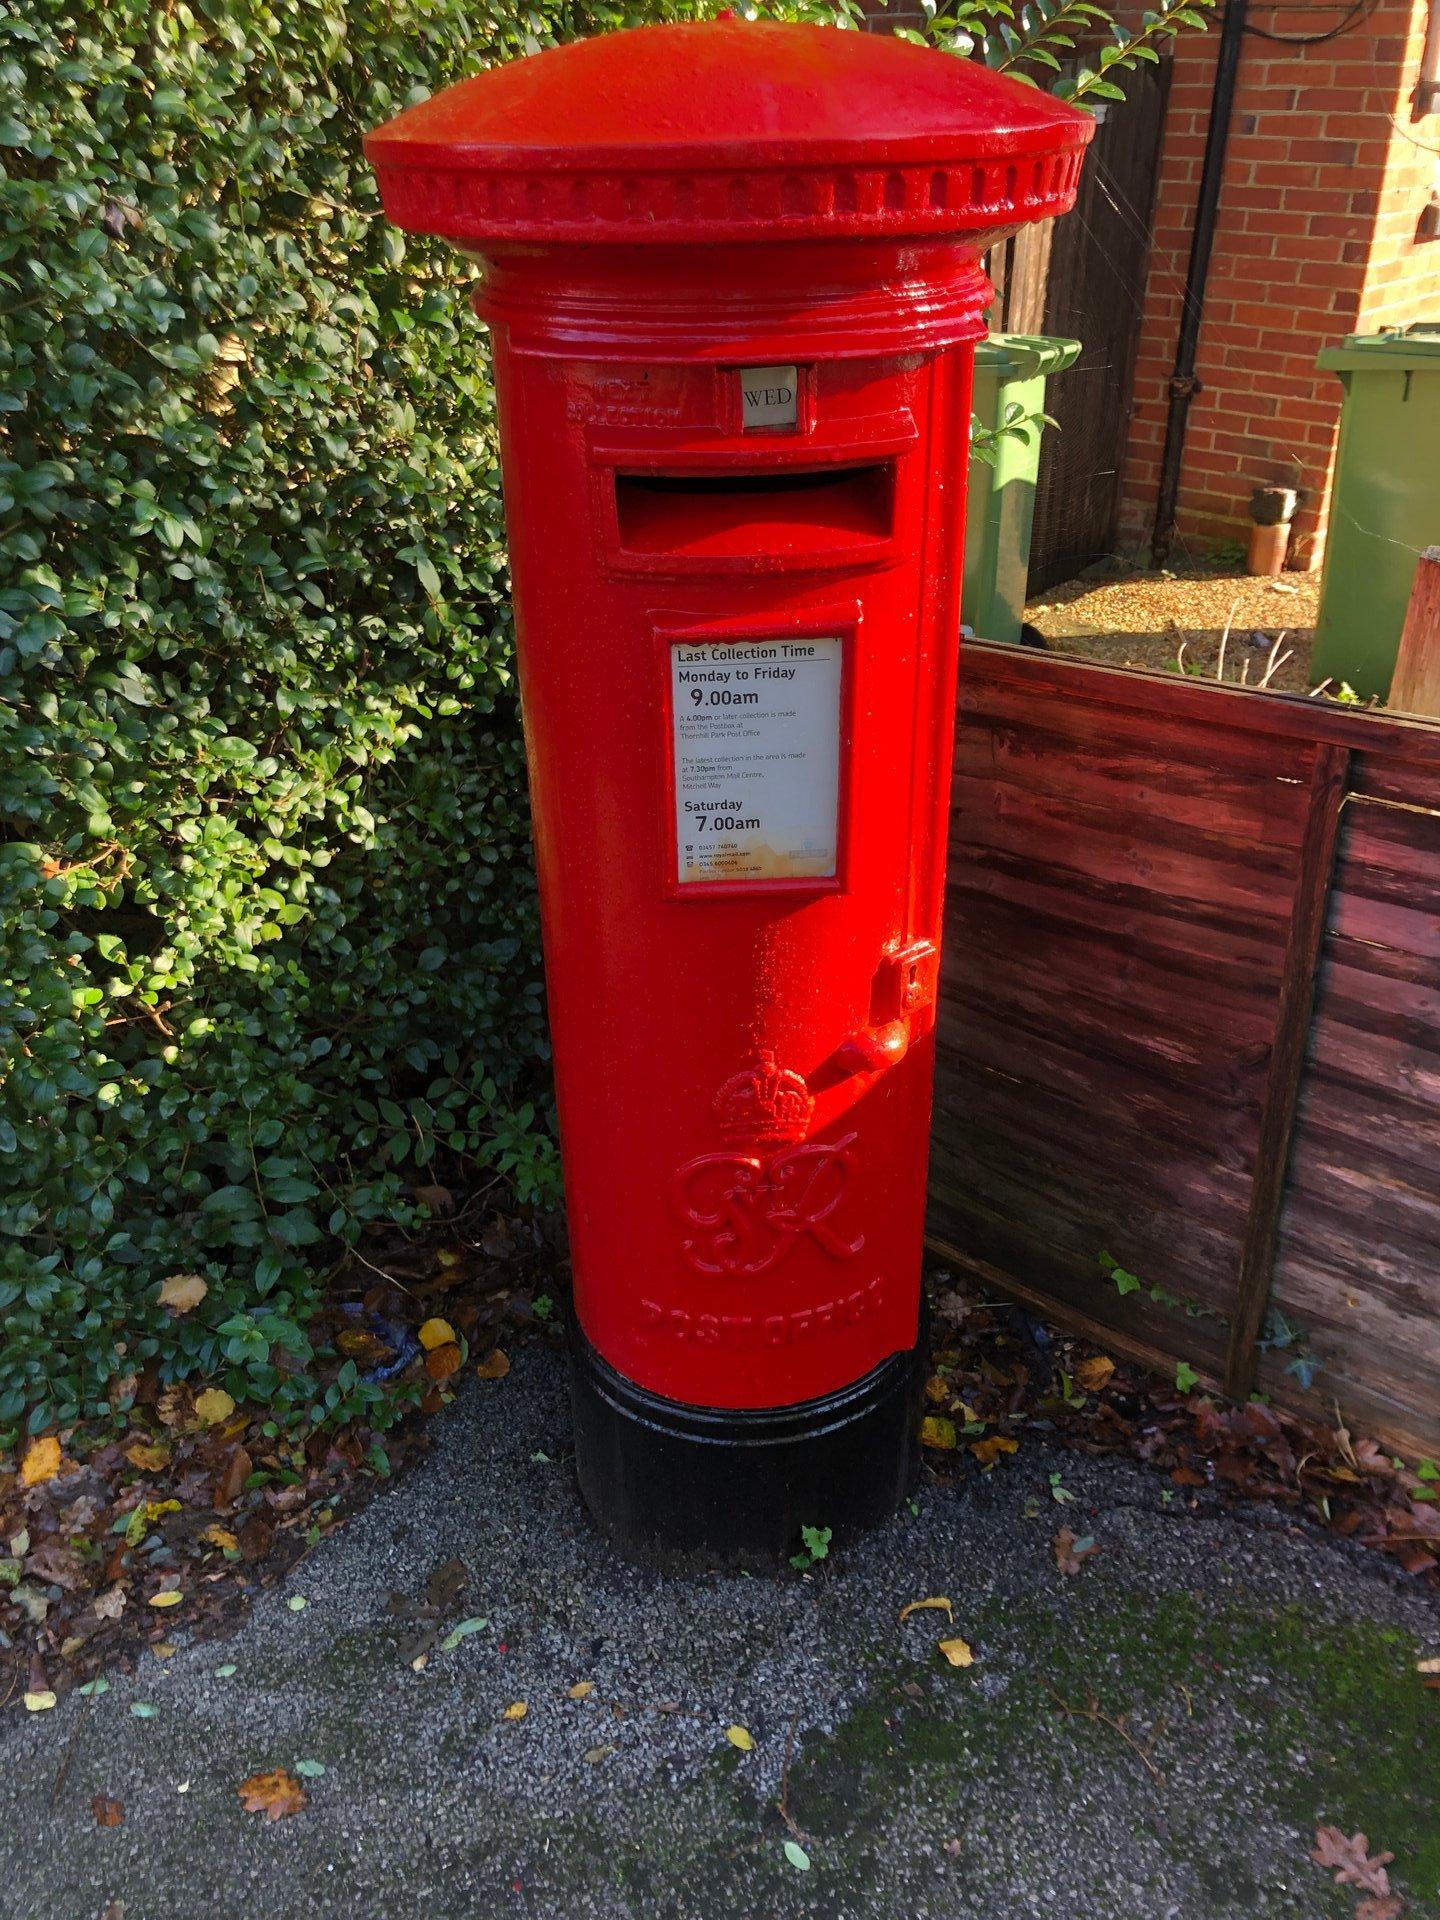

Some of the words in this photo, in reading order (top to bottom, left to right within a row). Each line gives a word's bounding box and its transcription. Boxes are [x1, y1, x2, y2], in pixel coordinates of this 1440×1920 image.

[744, 387, 792, 407] WED
[678, 650, 707, 662] Last
[711, 647, 777, 661] Collection
[781, 645, 815, 656] Time
[679, 670, 731, 683] Monday
[736, 670, 748, 680] to
[754, 667, 796, 680] Friday
[691, 688, 759, 707] 9.00am
[686, 715, 712, 723] 4.00pm
[710, 722, 735, 730] Postbox
[681, 732, 710, 740] Thornhill
[743, 730, 760, 738] Office
[696, 756, 712, 764] latest
[714, 755, 744, 763] collection
[690, 766, 716, 774] 7.30pm
[682, 774, 725, 783] Southampton
[685, 800, 743, 812] Saturday
[695, 816, 760, 832] 7.00am
[641, 1298, 751, 1343] POST
[765, 1276, 883, 1343] OFFICE
